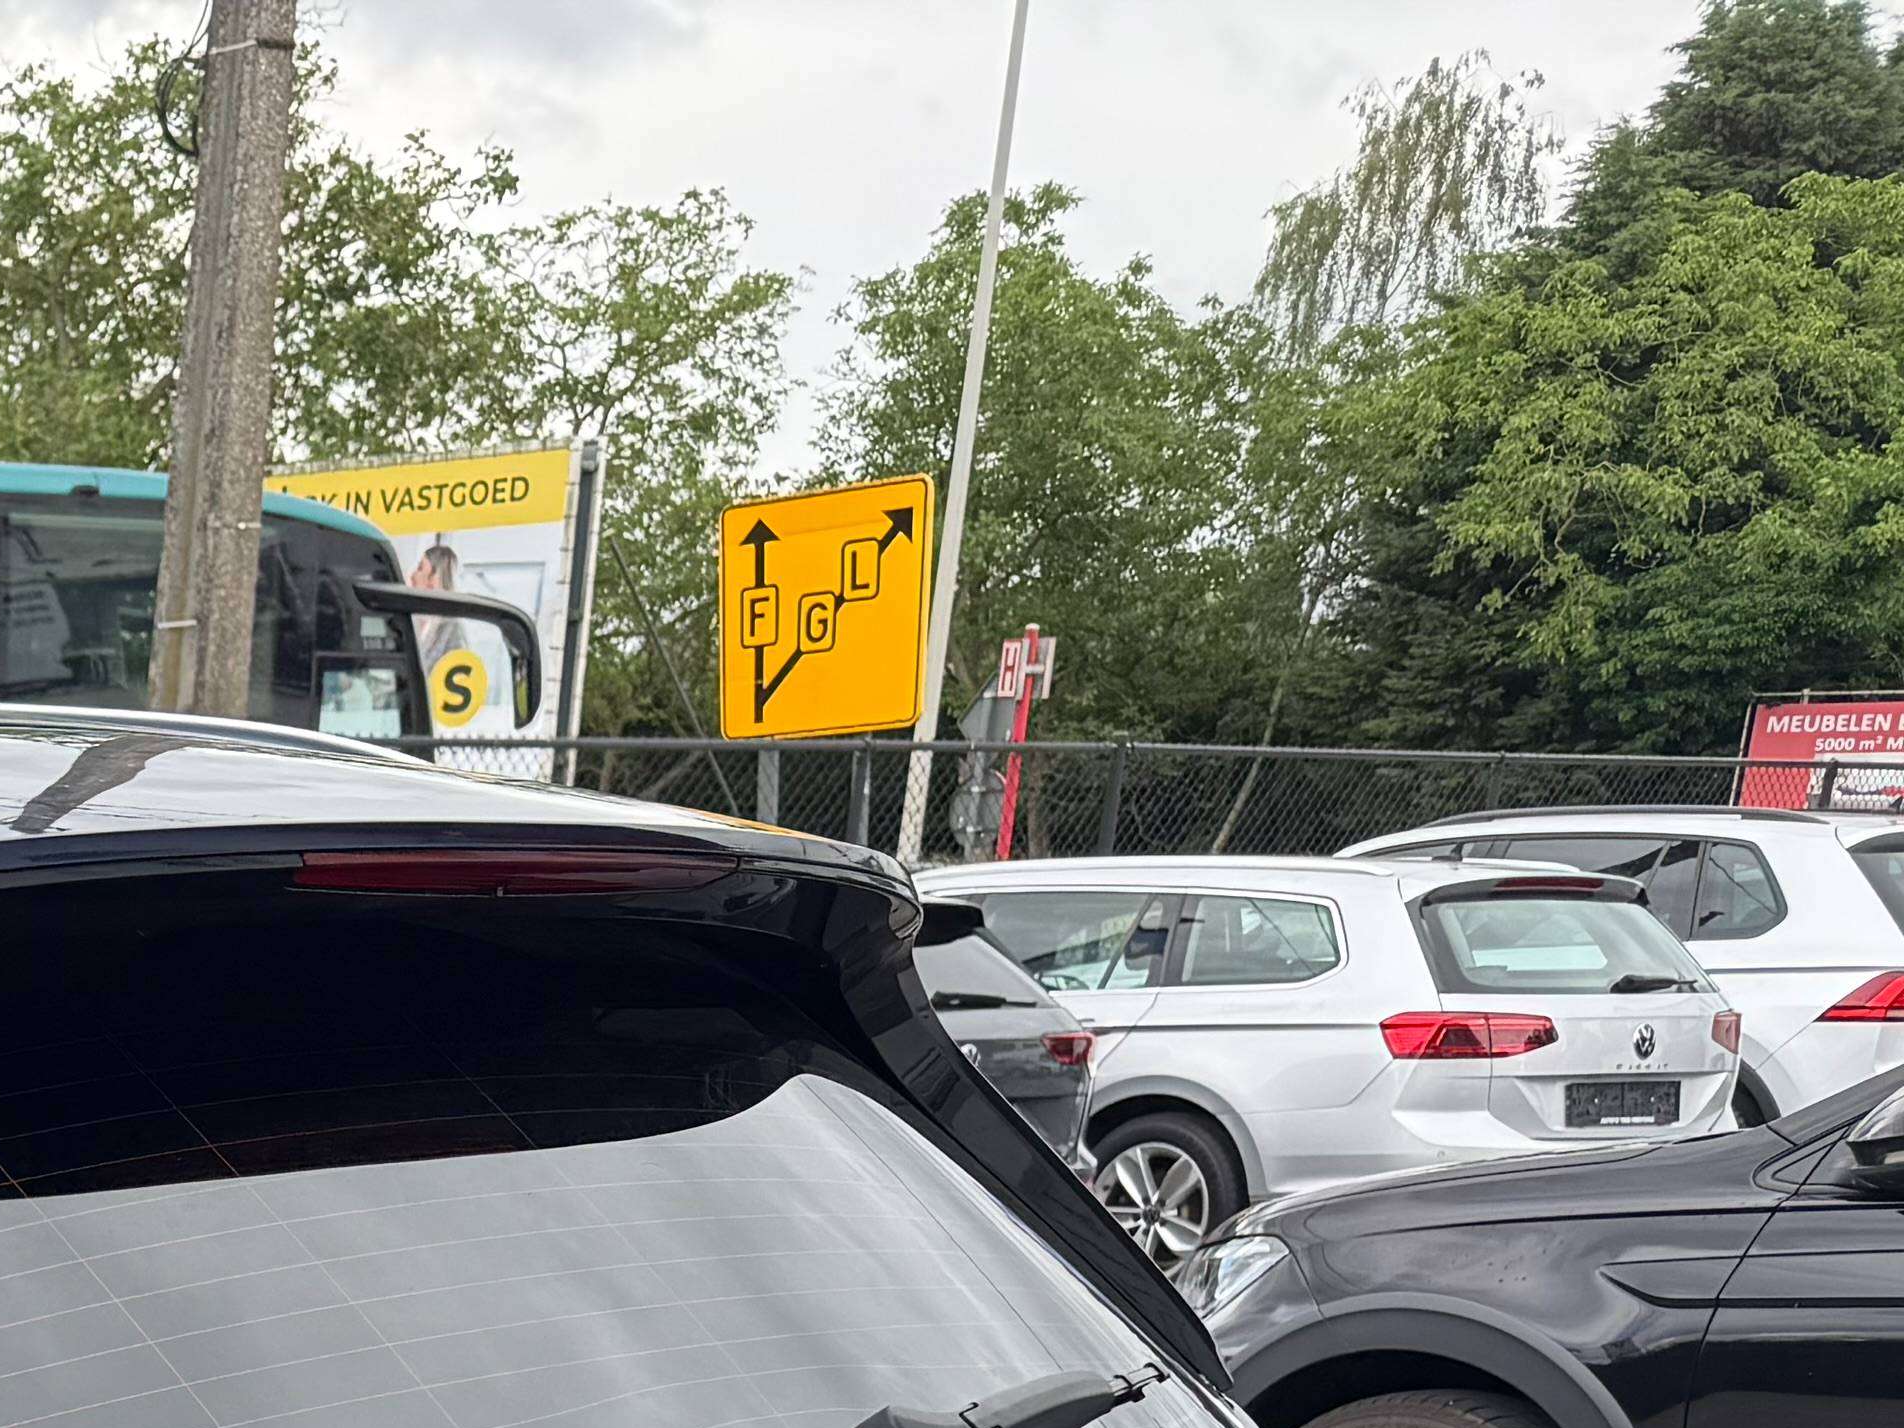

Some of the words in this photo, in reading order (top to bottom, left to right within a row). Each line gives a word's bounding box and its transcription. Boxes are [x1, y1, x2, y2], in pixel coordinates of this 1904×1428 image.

[345, 491, 371, 515] IN
[380, 476, 530, 514] VASTGOED
[850, 550, 870, 591] L
[749, 596, 770, 638] F
[806, 602, 829, 643] G
[442, 664, 472, 714] S
[1766, 713, 1893, 733] MEUBELEN
[1814, 737, 1856, 752] 5000
